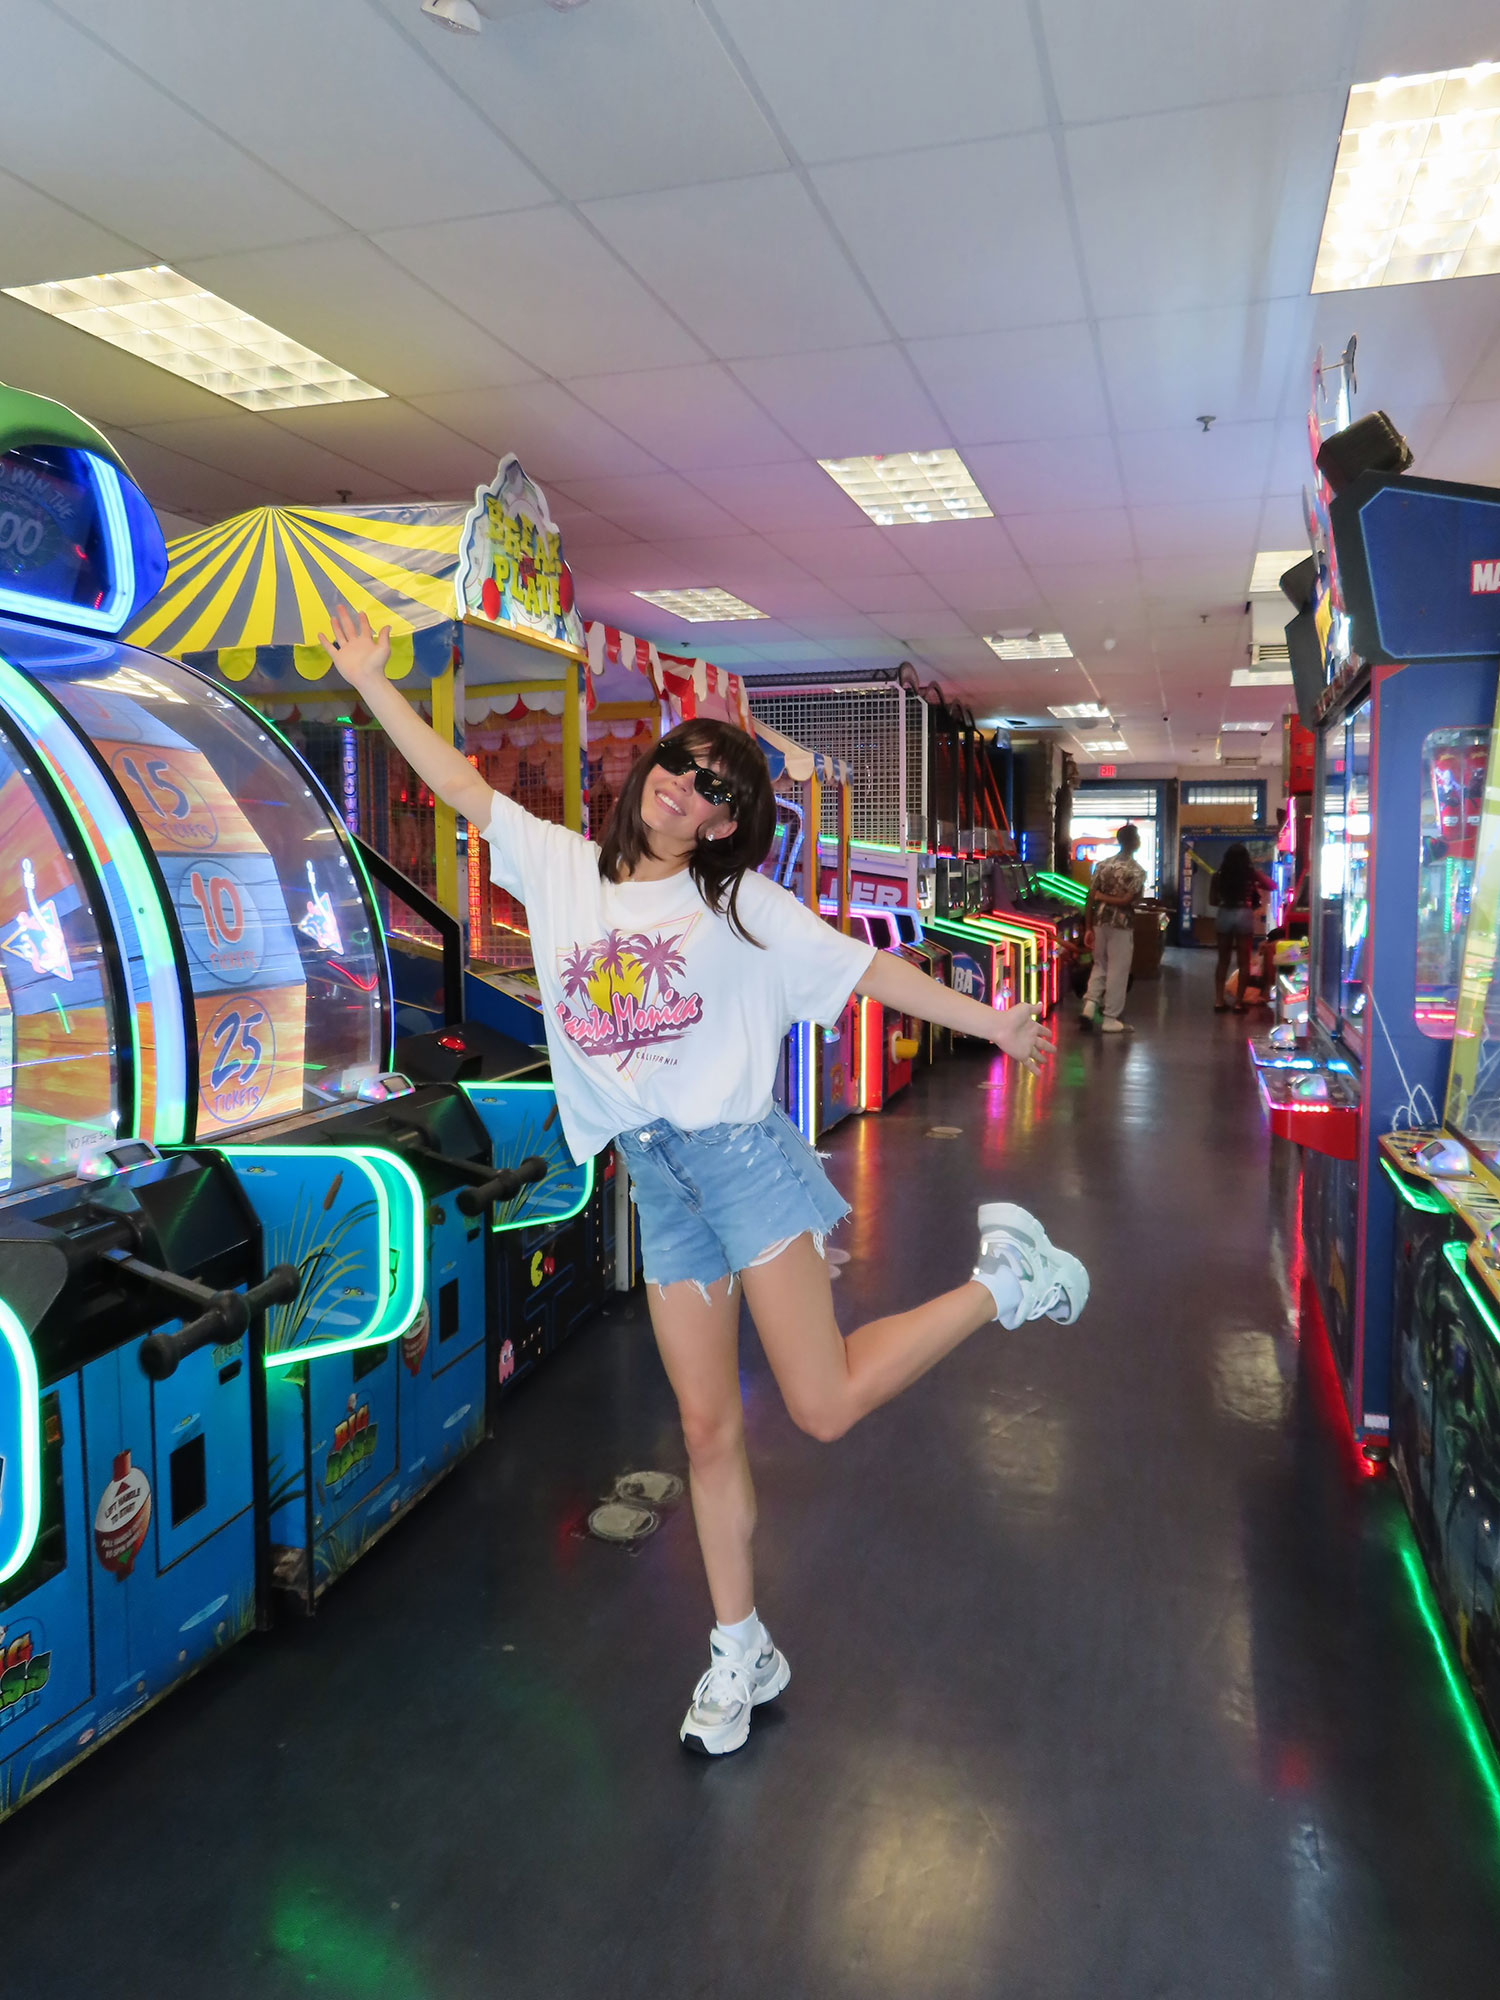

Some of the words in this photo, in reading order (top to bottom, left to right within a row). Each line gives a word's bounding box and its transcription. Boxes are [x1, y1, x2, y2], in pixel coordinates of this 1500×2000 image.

[12, 467, 51, 494] WIN
[485, 497, 563, 574] BREAK
[493, 555, 562, 617] PLATE
[122, 756, 190, 820] 15
[158, 821, 214, 840] TICKETS
[190, 871, 243, 949] 10
[953, 966, 973, 994] BA
[611, 988, 700, 1036] Monica
[211, 1010, 264, 1091] 25
[213, 1085, 261, 1112] TICKETS
[105, 1500, 118, 1519] LIFT
